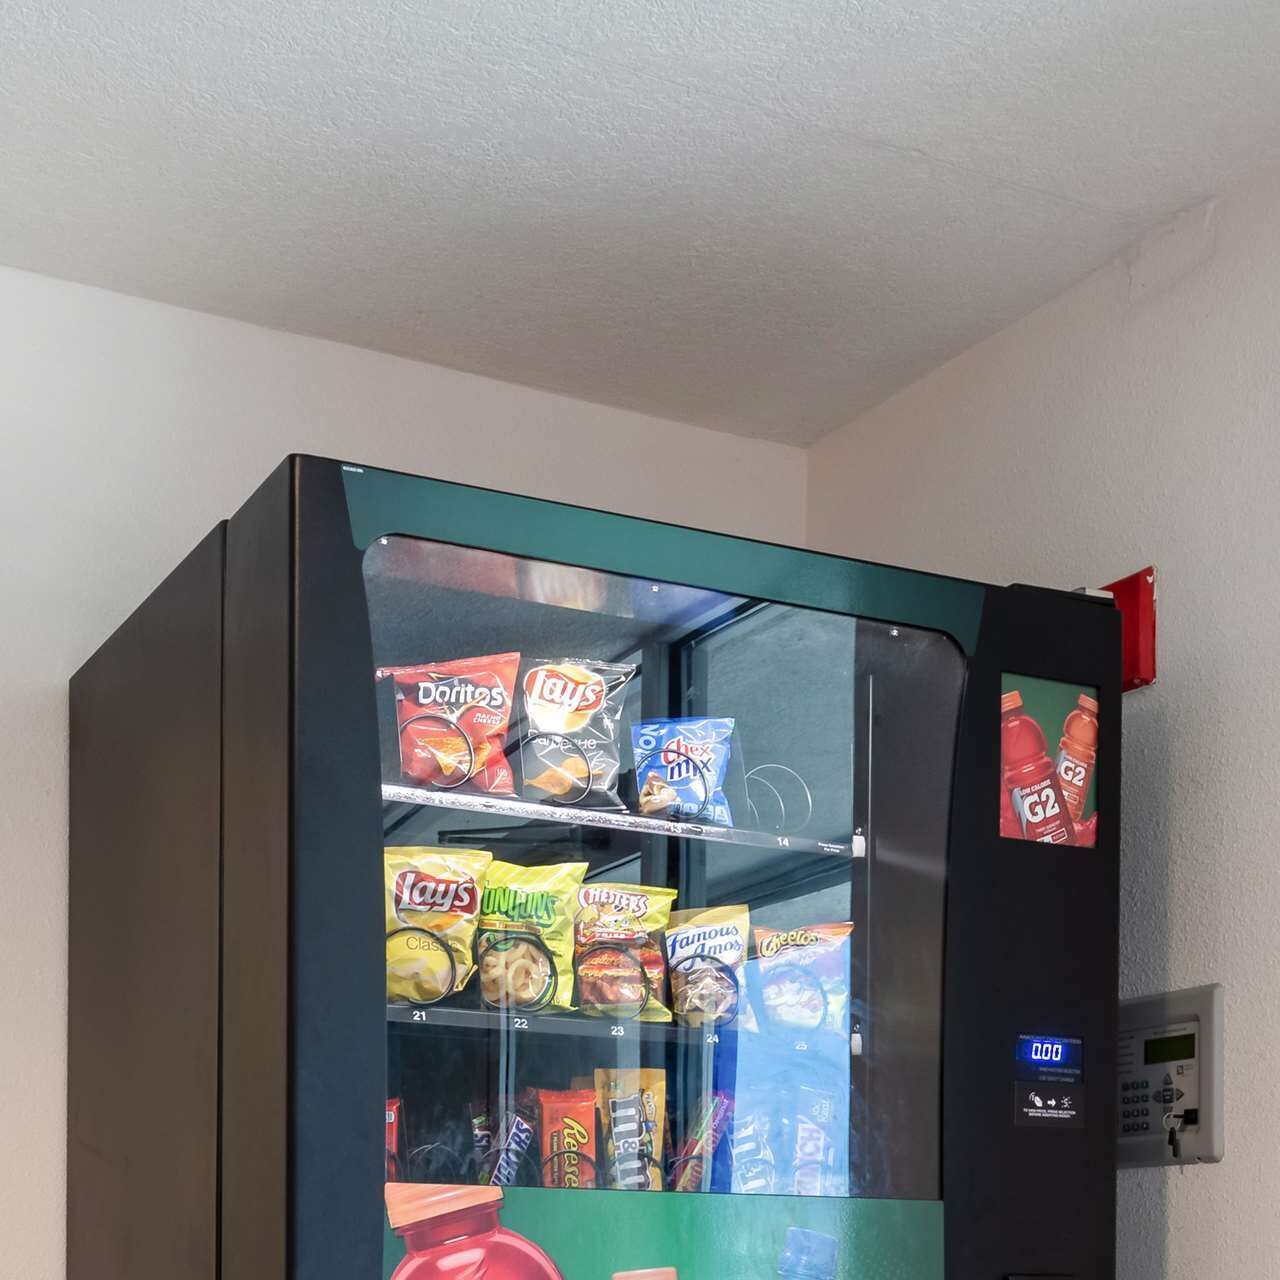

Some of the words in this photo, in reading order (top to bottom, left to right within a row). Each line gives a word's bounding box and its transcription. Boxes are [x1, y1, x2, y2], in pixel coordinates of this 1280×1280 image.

[418, 680, 506, 706] Doritos
[662, 737, 711, 765] Chex
[668, 758, 712, 780] mix
[1060, 760, 1086, 787] G2
[1023, 788, 1060, 823] G2
[777, 836, 789, 847] 14
[667, 924, 739, 959] Famous
[761, 931, 818, 957] Cheetos
[684, 938, 743, 972] Amos
[412, 1011, 426, 1021] 21
[514, 1018, 528, 1029] 22
[611, 1026, 624, 1036] 23
[706, 1034, 719, 1044] 24
